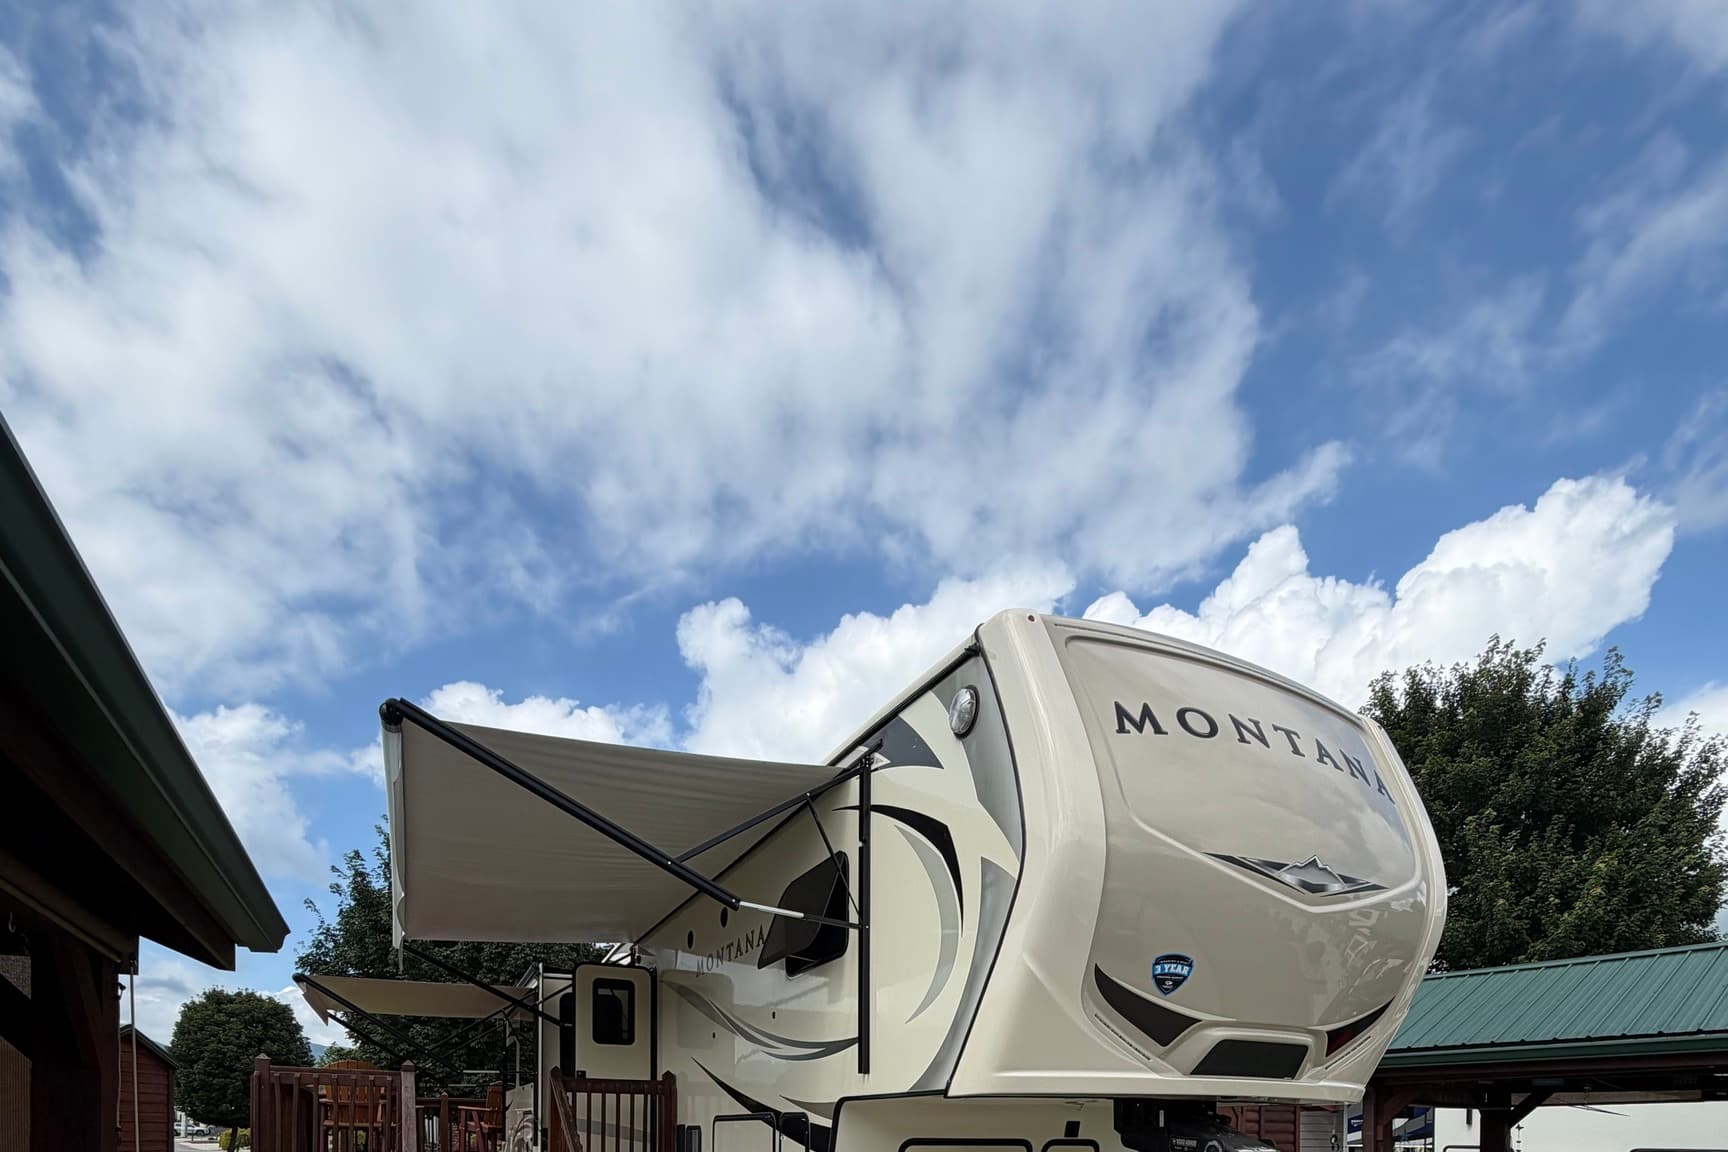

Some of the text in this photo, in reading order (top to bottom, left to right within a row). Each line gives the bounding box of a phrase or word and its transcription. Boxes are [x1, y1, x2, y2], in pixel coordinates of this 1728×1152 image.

[1114, 701, 1396, 805] MONTANA
[696, 924, 765, 978] MONTANA
[1163, 963, 1189, 976] YEAR
